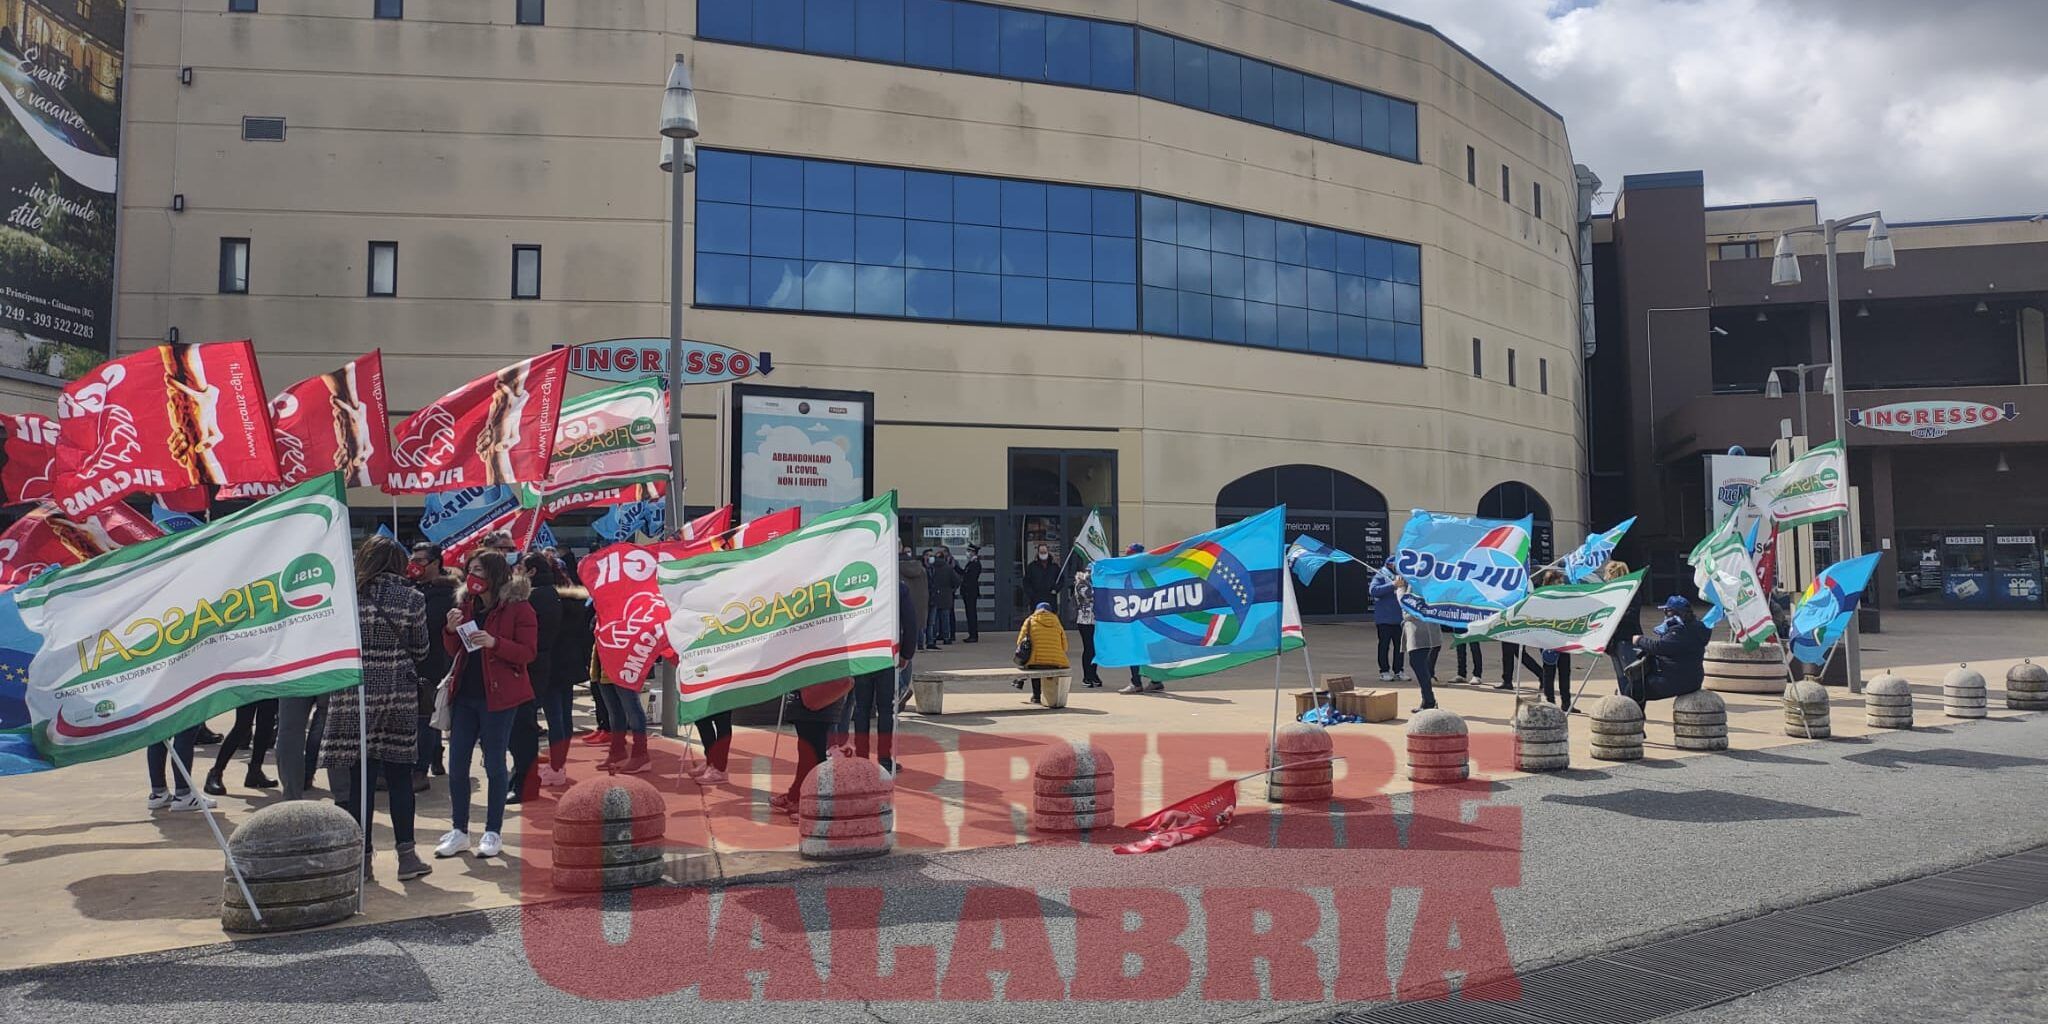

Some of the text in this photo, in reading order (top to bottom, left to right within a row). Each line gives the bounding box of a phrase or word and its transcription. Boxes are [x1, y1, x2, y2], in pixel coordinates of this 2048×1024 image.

[17, 47, 71, 91] Eventi
[15, 87, 25, 100] e
[44, 193, 96, 222] grande
[6, 305, 25, 321] 249
[33, 312, 52, 328] 393
[54, 318, 71, 333] 522
[73, 322, 94, 339] 2283
[572, 347, 752, 376] INGRSSO
[1864, 405, 1998, 426] INGRESSO
[772, 452, 832, 464] ABBANDONIAMO
[786, 465, 793, 474] IL
[777, 477, 793, 486] NON
[799, 478, 828, 487] RIFIUTI!
[925, 527, 967, 537] INGRESSO
[1284, 522, 1330, 531] merican Jeans
[1998, 536, 2034, 544] INGRESSO
